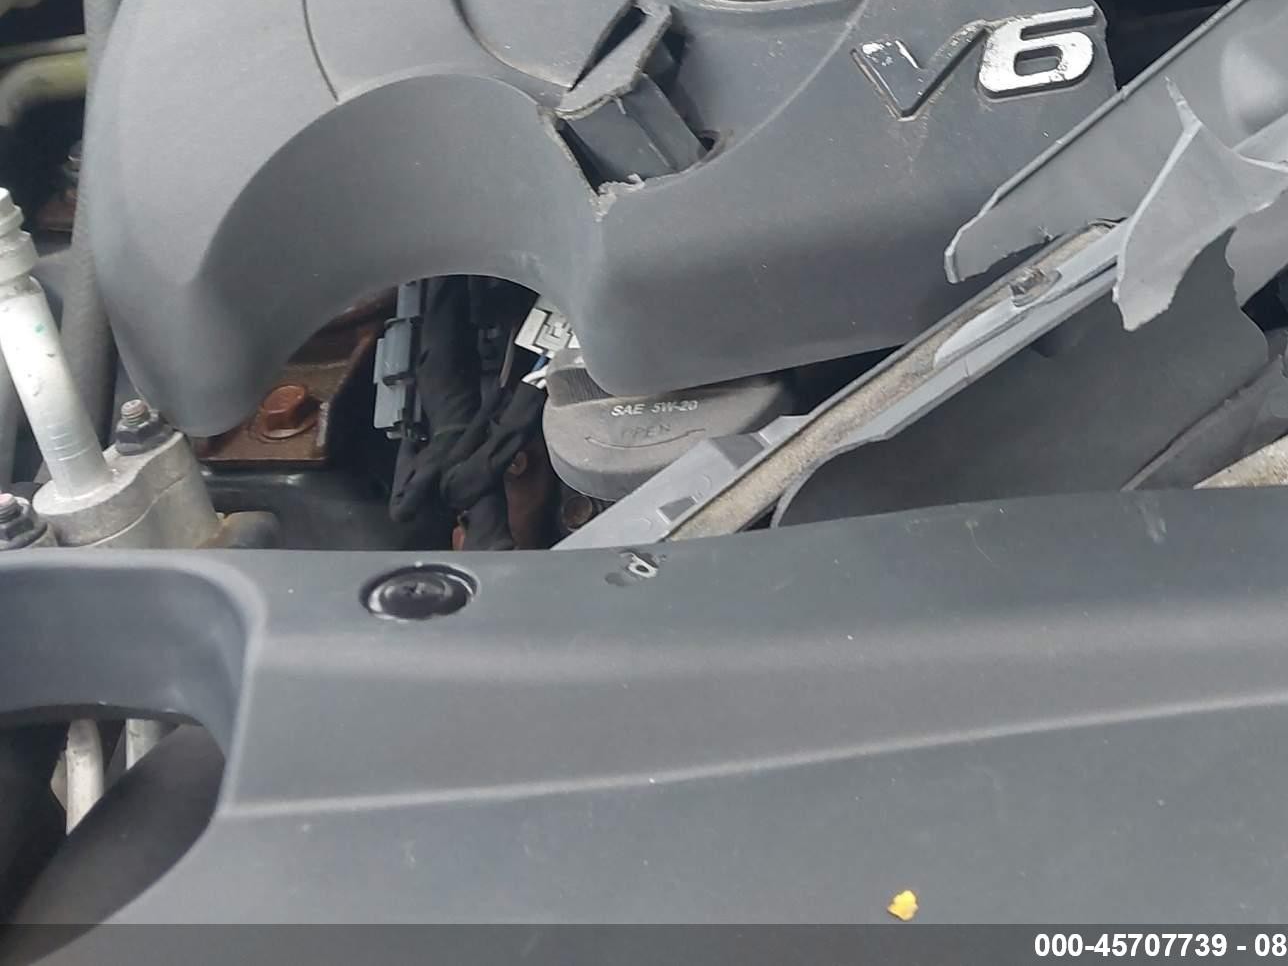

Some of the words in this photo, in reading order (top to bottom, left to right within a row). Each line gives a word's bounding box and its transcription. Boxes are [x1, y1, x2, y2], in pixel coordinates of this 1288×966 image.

[852, 6, 1097, 120] V6
[611, 403, 645, 417] SAE
[651, 400, 698, 414] 5W-20
